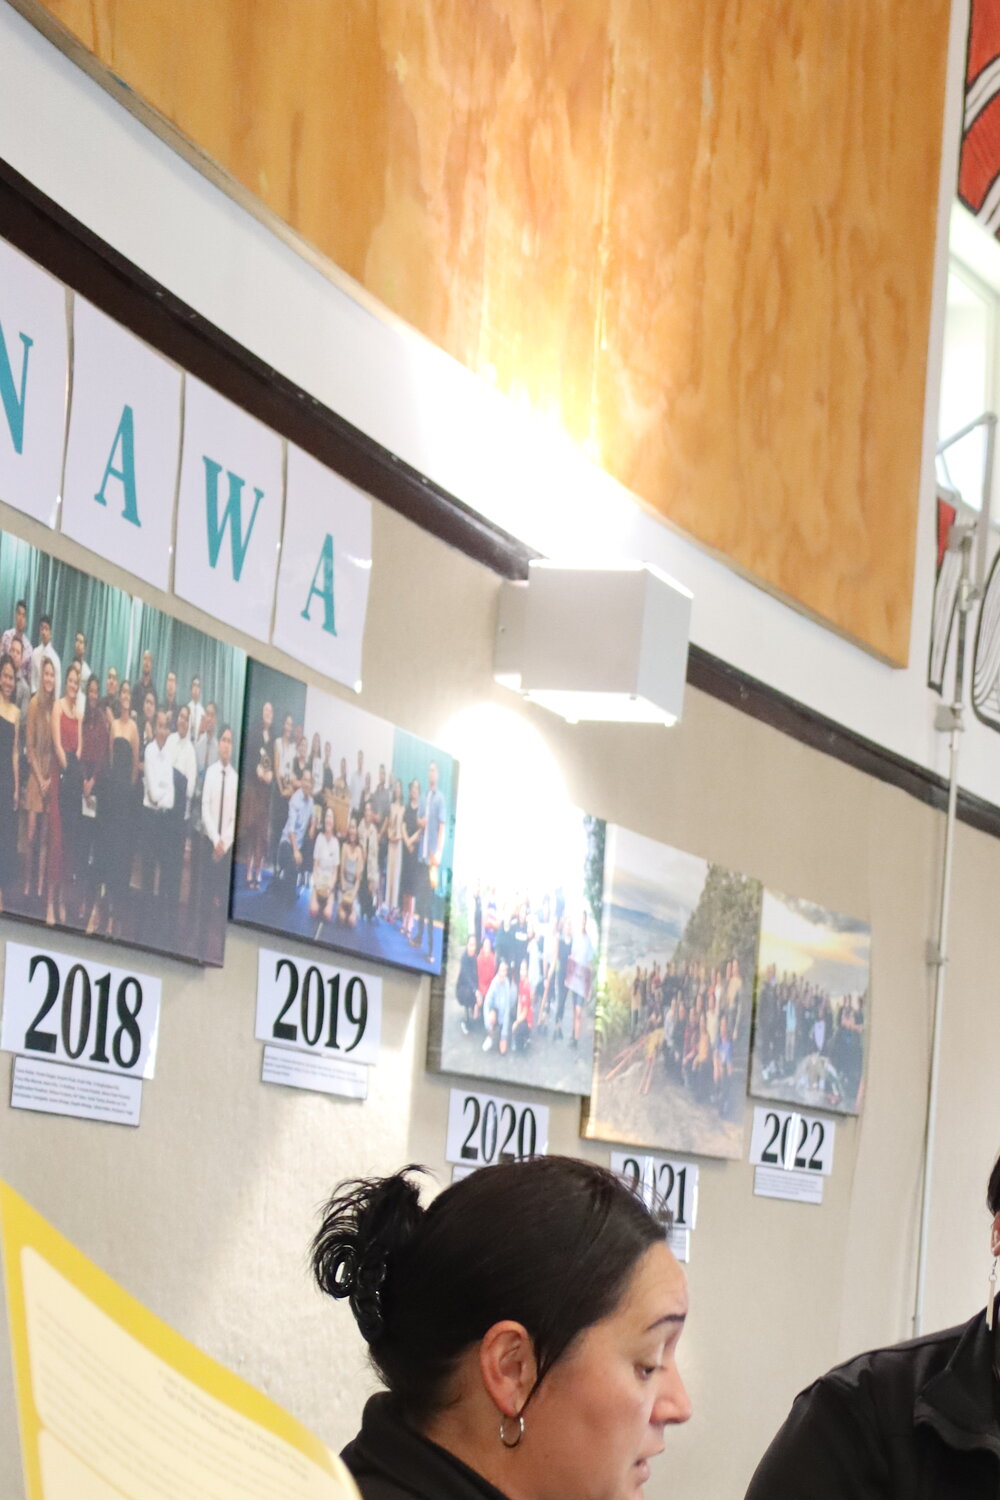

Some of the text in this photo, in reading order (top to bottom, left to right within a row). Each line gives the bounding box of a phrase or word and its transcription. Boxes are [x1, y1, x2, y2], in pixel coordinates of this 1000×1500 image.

[24, 954, 143, 1068] 2018
[272, 958, 368, 1052] 2019
[460, 1096, 537, 1163] 2020
